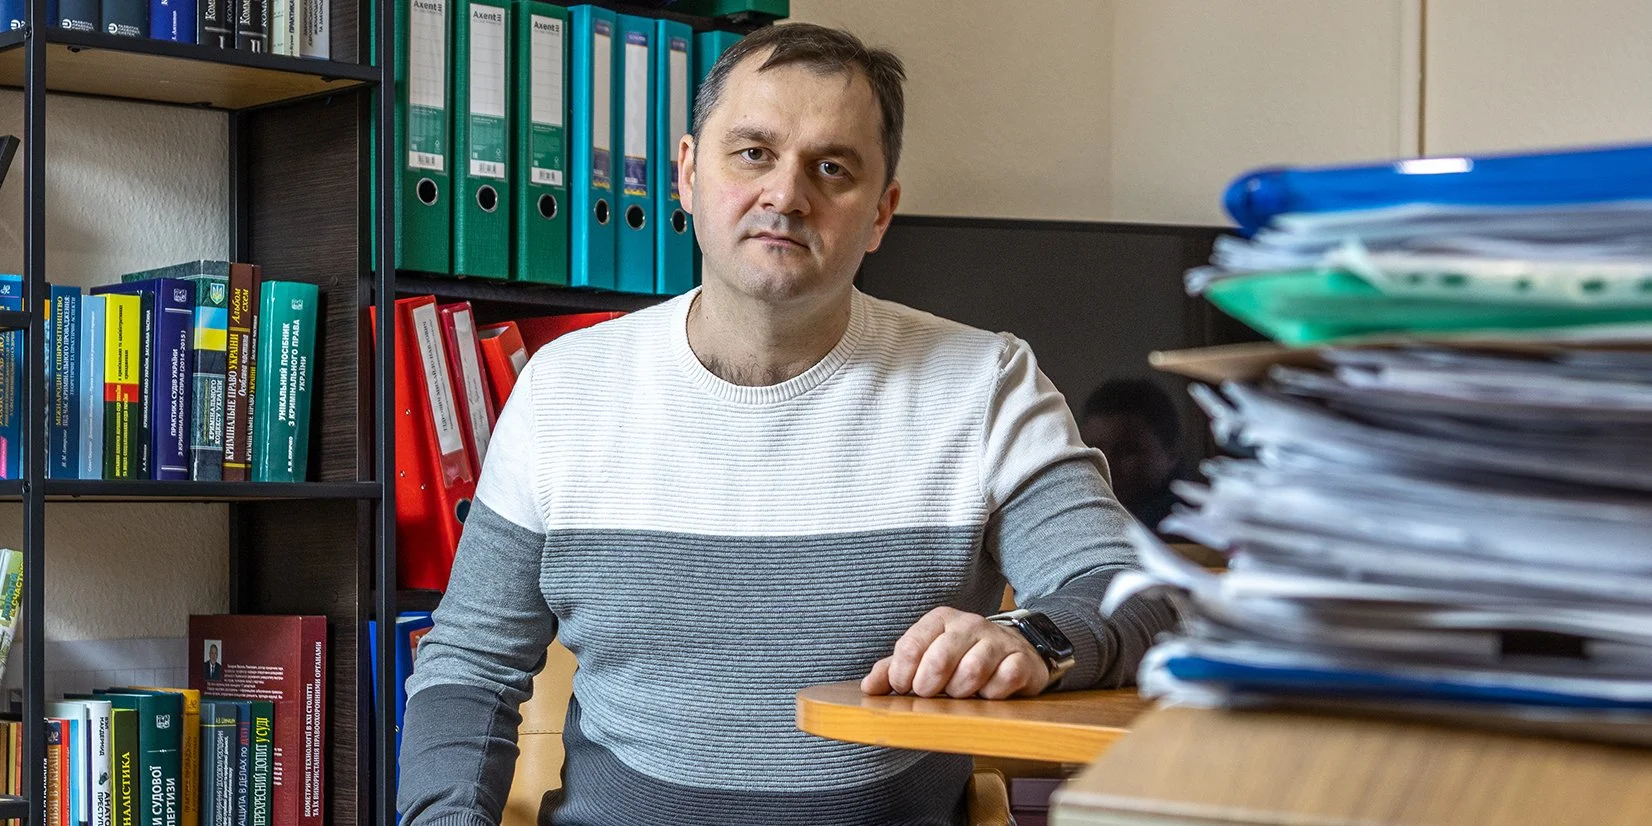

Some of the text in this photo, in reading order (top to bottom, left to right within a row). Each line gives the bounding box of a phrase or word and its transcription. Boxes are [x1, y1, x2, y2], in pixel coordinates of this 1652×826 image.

[414, 0, 437, 11] Axent
[473, 11, 497, 21] Axent
[534, 21, 555, 32] Axent
[232, 288, 242, 324] Альбом
[241, 288, 250, 312] схем
[291, 319, 300, 346] ПРАВА
[171, 348, 179, 378] УКРАЇНИ
[237, 335, 249, 397] Особлива частина
[278, 323, 290, 421] УНІКАЛЬНИЙ ПОСІБНИК
[298, 355, 307, 392] УКРАЇНИ
[225, 334, 239, 461] КРИМІНАЛЬНЕ ПРАВО УКРАЇНИ
[288, 350, 298, 419] КРИМІНАЛЬНОГО
[209, 379, 217, 440] КРИМІНАЛЬНОГО
[214, 379, 223, 444] КОДЕКСУ УКРАЇНИ
[256, 717, 270, 737] СУДІ
[239, 758, 248, 787] ДЕЛАХ
[255, 744, 268, 772] ДОПИТ
[122, 752, 131, 826] НАЛІСТИКА
[149, 766, 164, 815] СУДОВОЇ
[166, 778, 176, 826] ПЕРТИЗИ
[253, 772, 267, 826] ПЕРЕХРЕСНИЙ
[238, 795, 247, 826] АЩИТА
